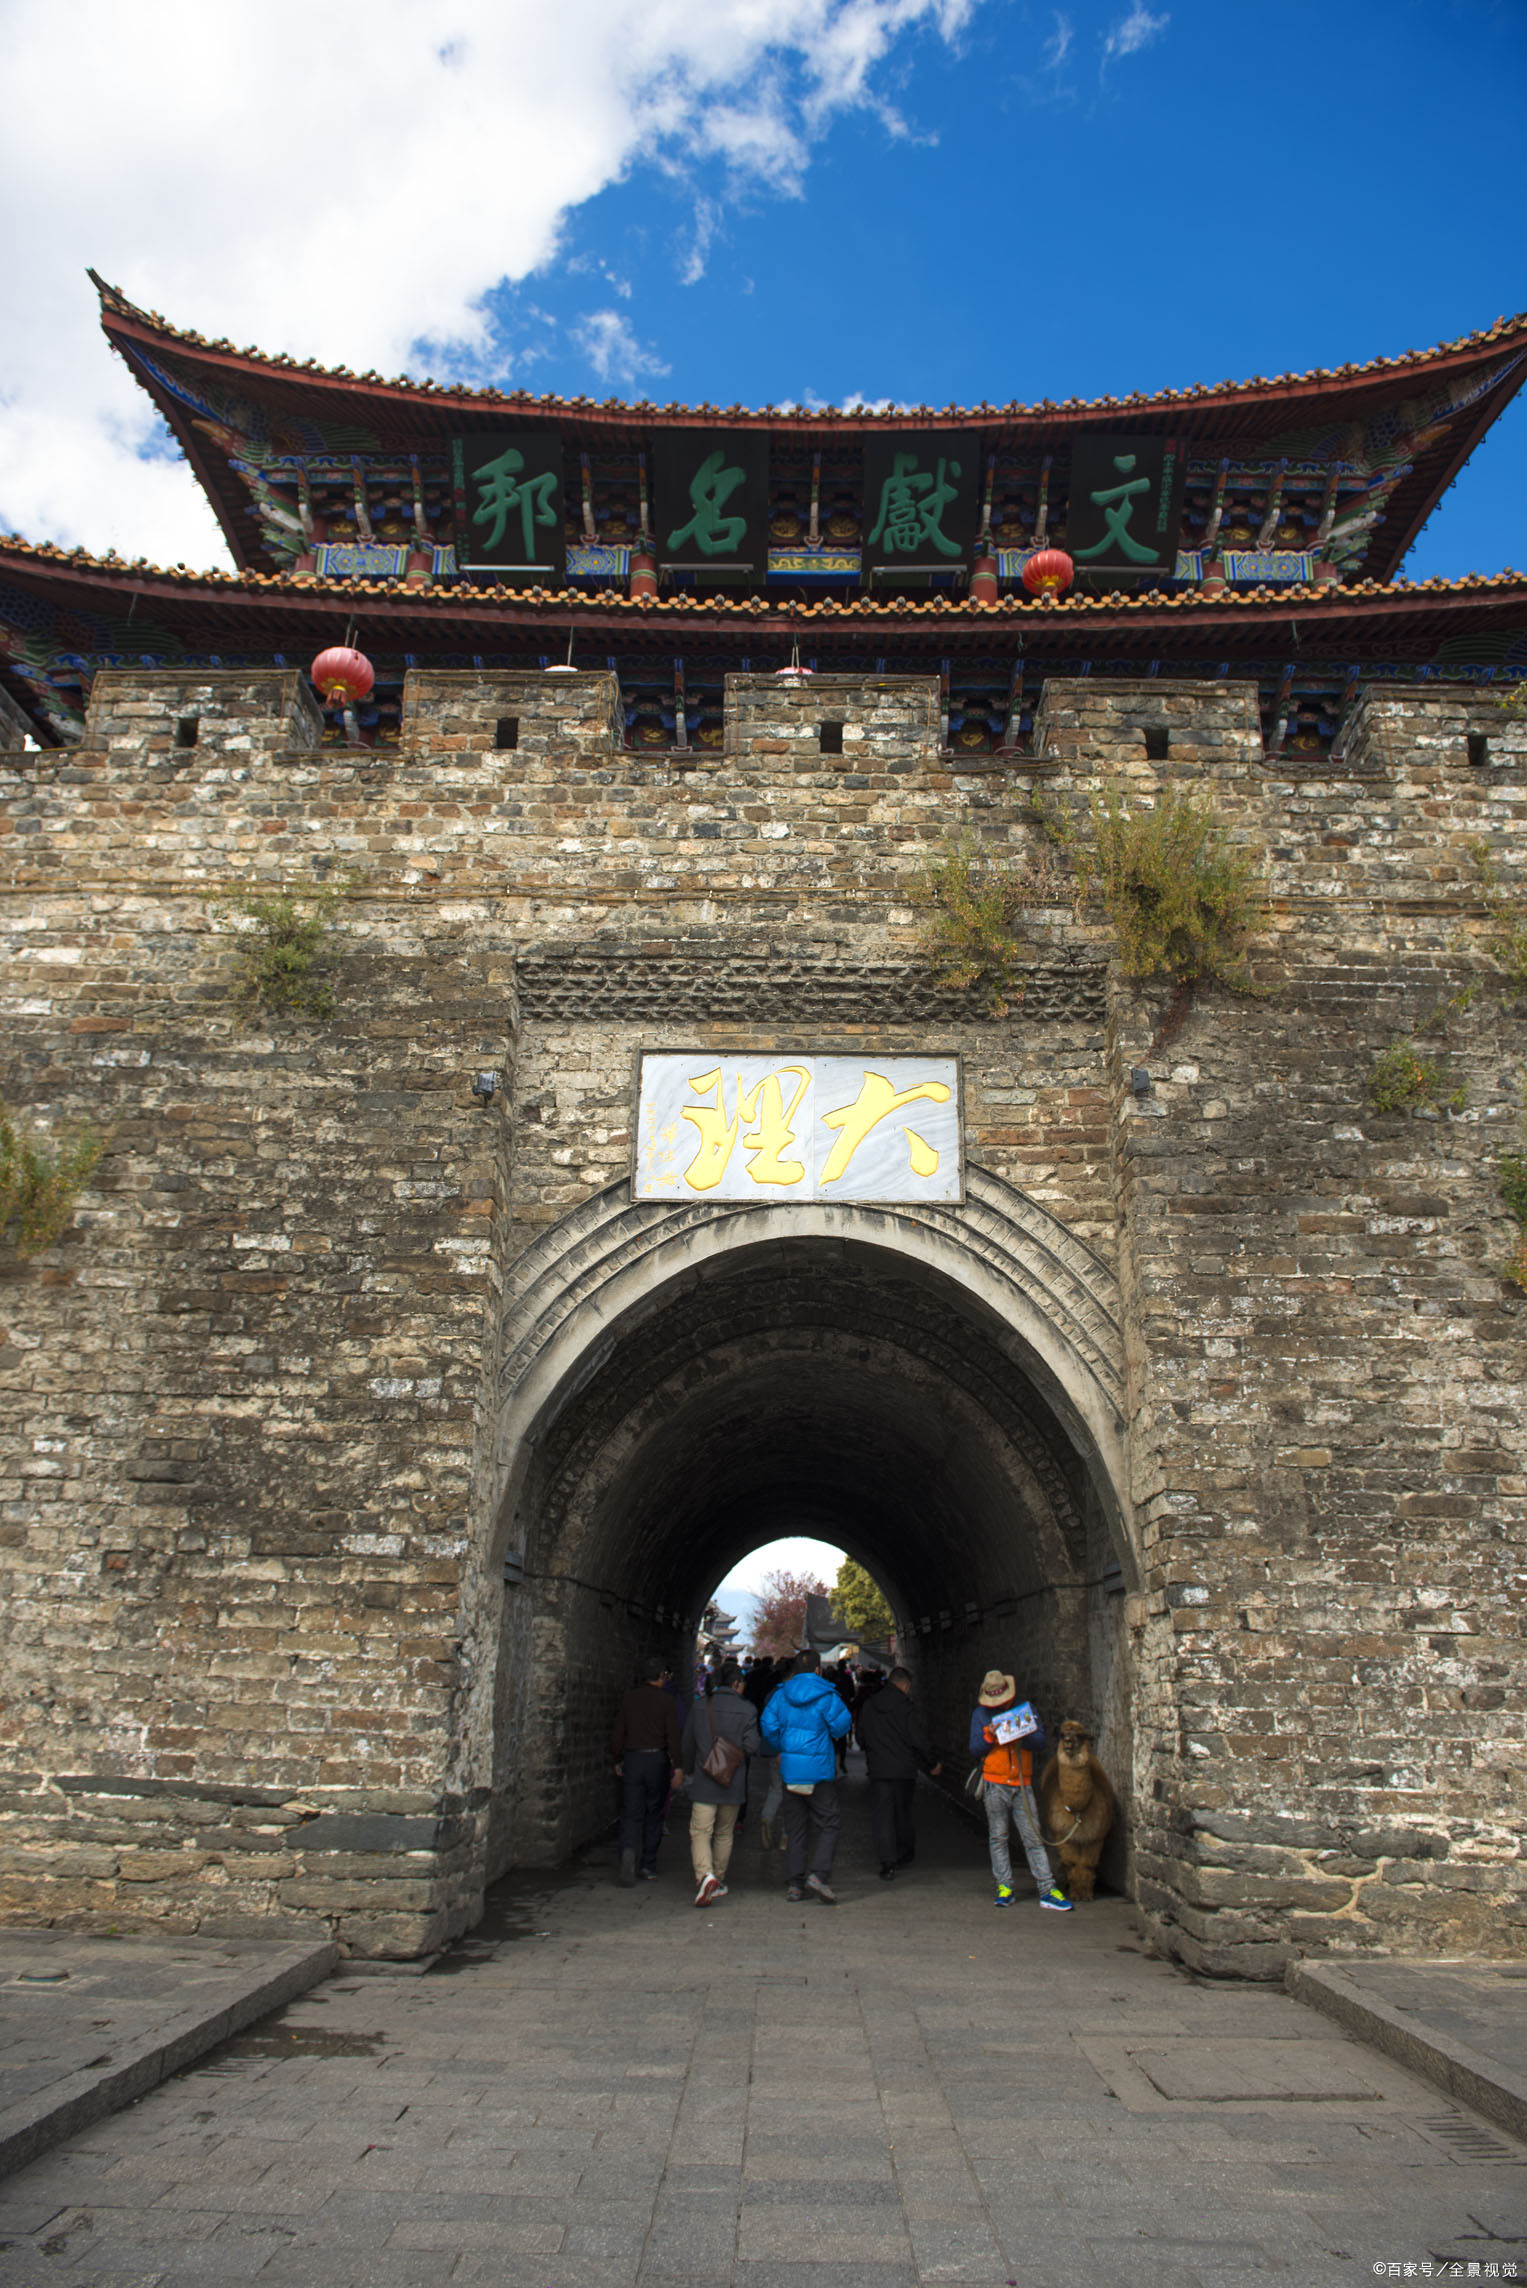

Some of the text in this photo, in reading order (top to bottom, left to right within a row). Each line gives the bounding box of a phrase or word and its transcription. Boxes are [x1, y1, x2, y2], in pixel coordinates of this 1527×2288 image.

[471, 448, 558, 562] 邦
[667, 451, 747, 555] 名
[1074, 454, 1160, 563] 文
